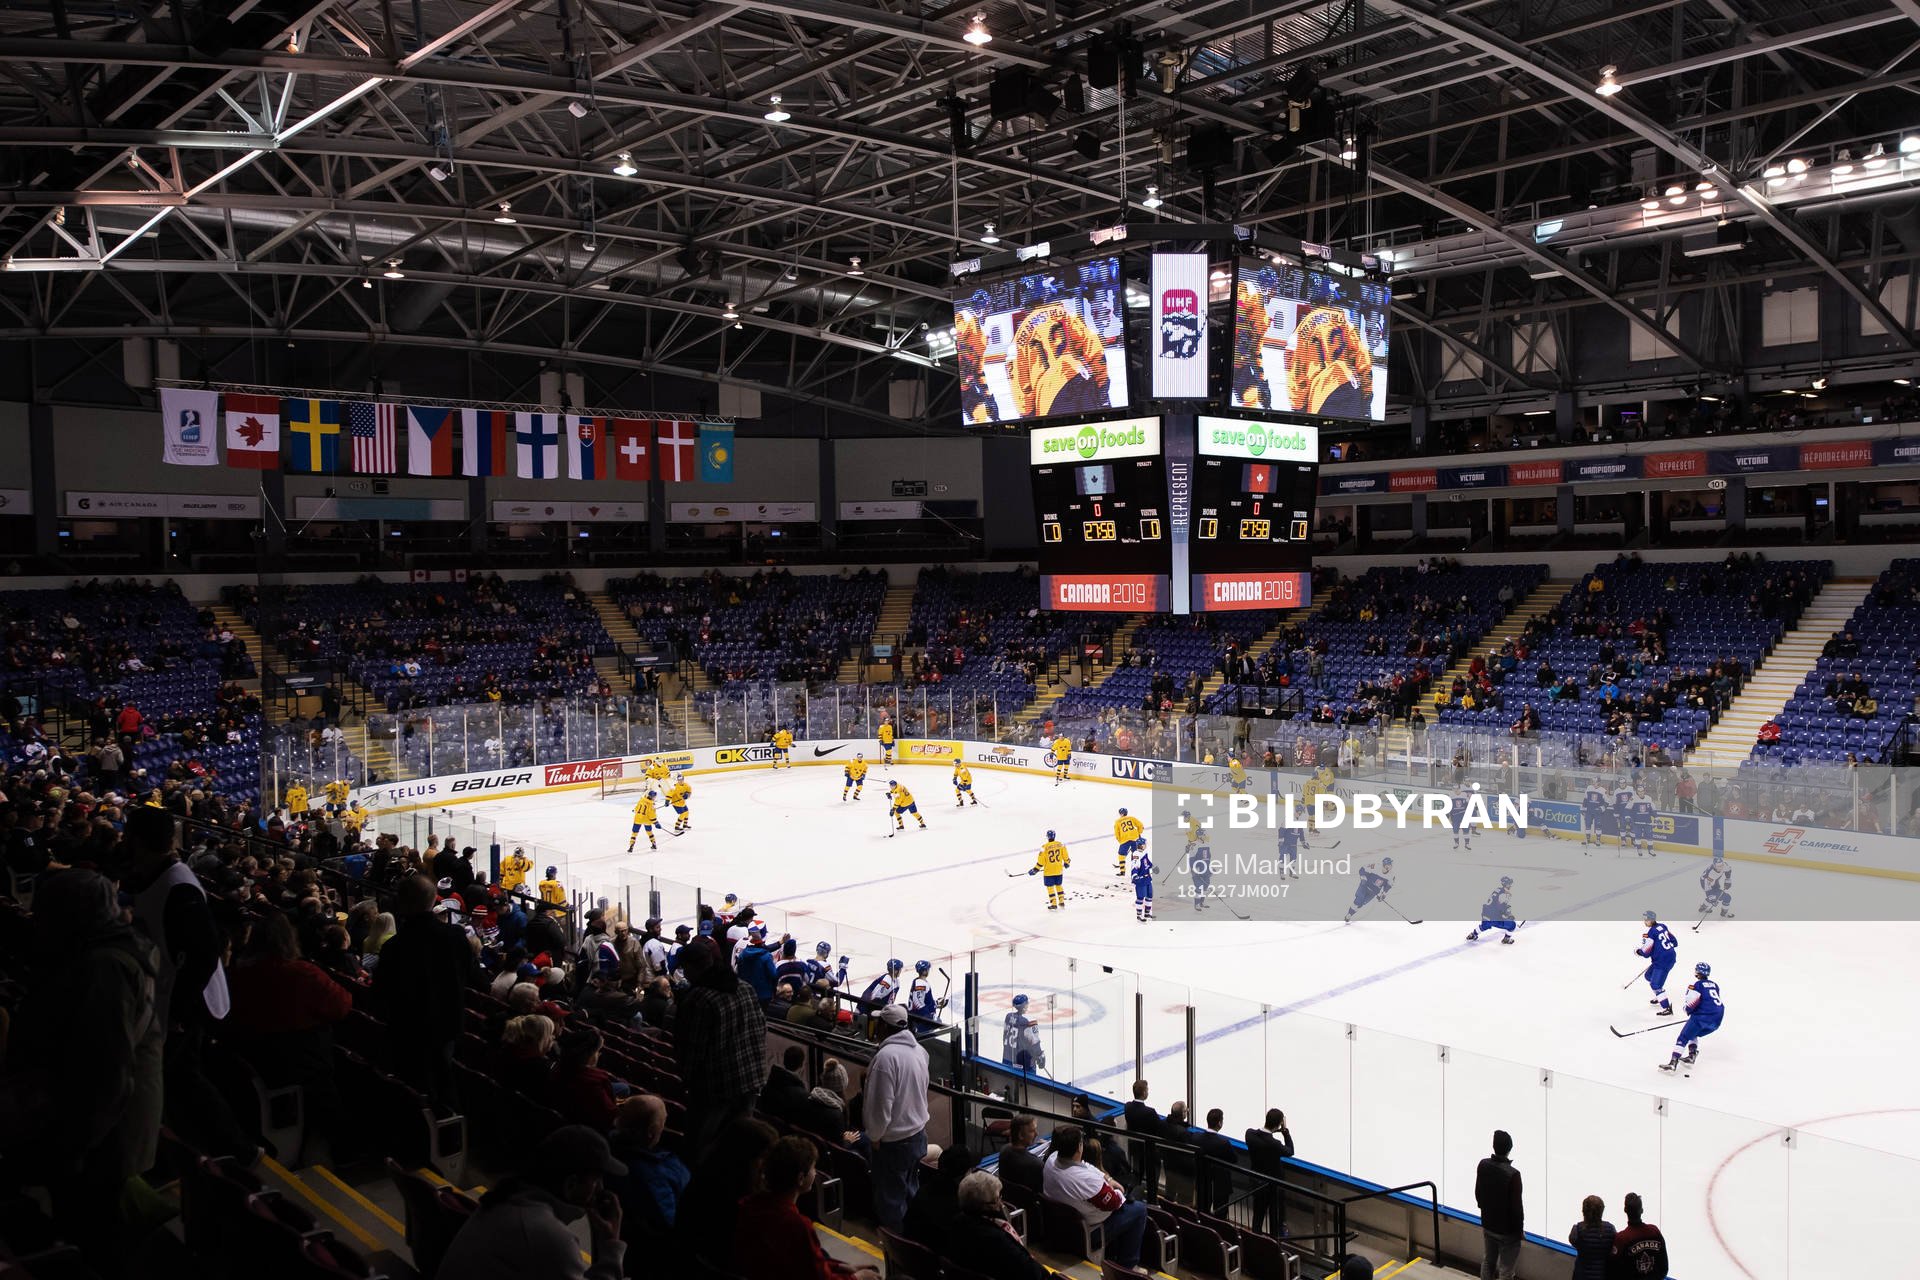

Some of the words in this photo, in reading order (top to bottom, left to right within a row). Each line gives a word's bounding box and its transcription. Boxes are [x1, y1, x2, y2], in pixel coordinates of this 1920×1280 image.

[1166, 297, 1193, 308] IIHF
[1043, 436, 1075, 453] save
[1078, 435, 1097, 450] on
[1099, 425, 1145, 448] foods
[1212, 429, 1245, 446] save
[1247, 432, 1265, 448] on
[1267, 429, 1307, 450] foods
[1735, 456, 1769, 466] VICTORIA
[1579, 464, 1626, 475] CHAMPIONSHIP
[1094, 503, 1102, 517] 0
[1253, 502, 1260, 515] 0
[1052, 524, 1061, 540] 0
[1084, 522, 1115, 540] 27:58
[1150, 520, 1159, 538] 0
[1208, 520, 1216, 537] 0
[1241, 521, 1269, 538] 27:58
[1299, 522, 1306, 538] 0
[1060, 583, 1110, 603] CANADA
[1112, 583, 1146, 604] 2019
[1213, 581, 1262, 602] CANADA
[1264, 580, 1293, 601] 2019
[716, 748, 747, 763] OK
[978, 753, 1028, 767] CHEVROLET
[1072, 758, 1097, 770] Synergy
[1114, 758, 1155, 780] UVIC
[547, 768, 567, 784] Tim
[389, 783, 437, 800] TELUS
[1545, 808, 1577, 824] Extras
[1120, 820, 1135, 833] 29
[1768, 836, 1790, 845] AMJ
[1799, 840, 1859, 852] CAMPBELL
[1048, 849, 1060, 863] 22
[1631, 1241, 1660, 1254] CANADA
